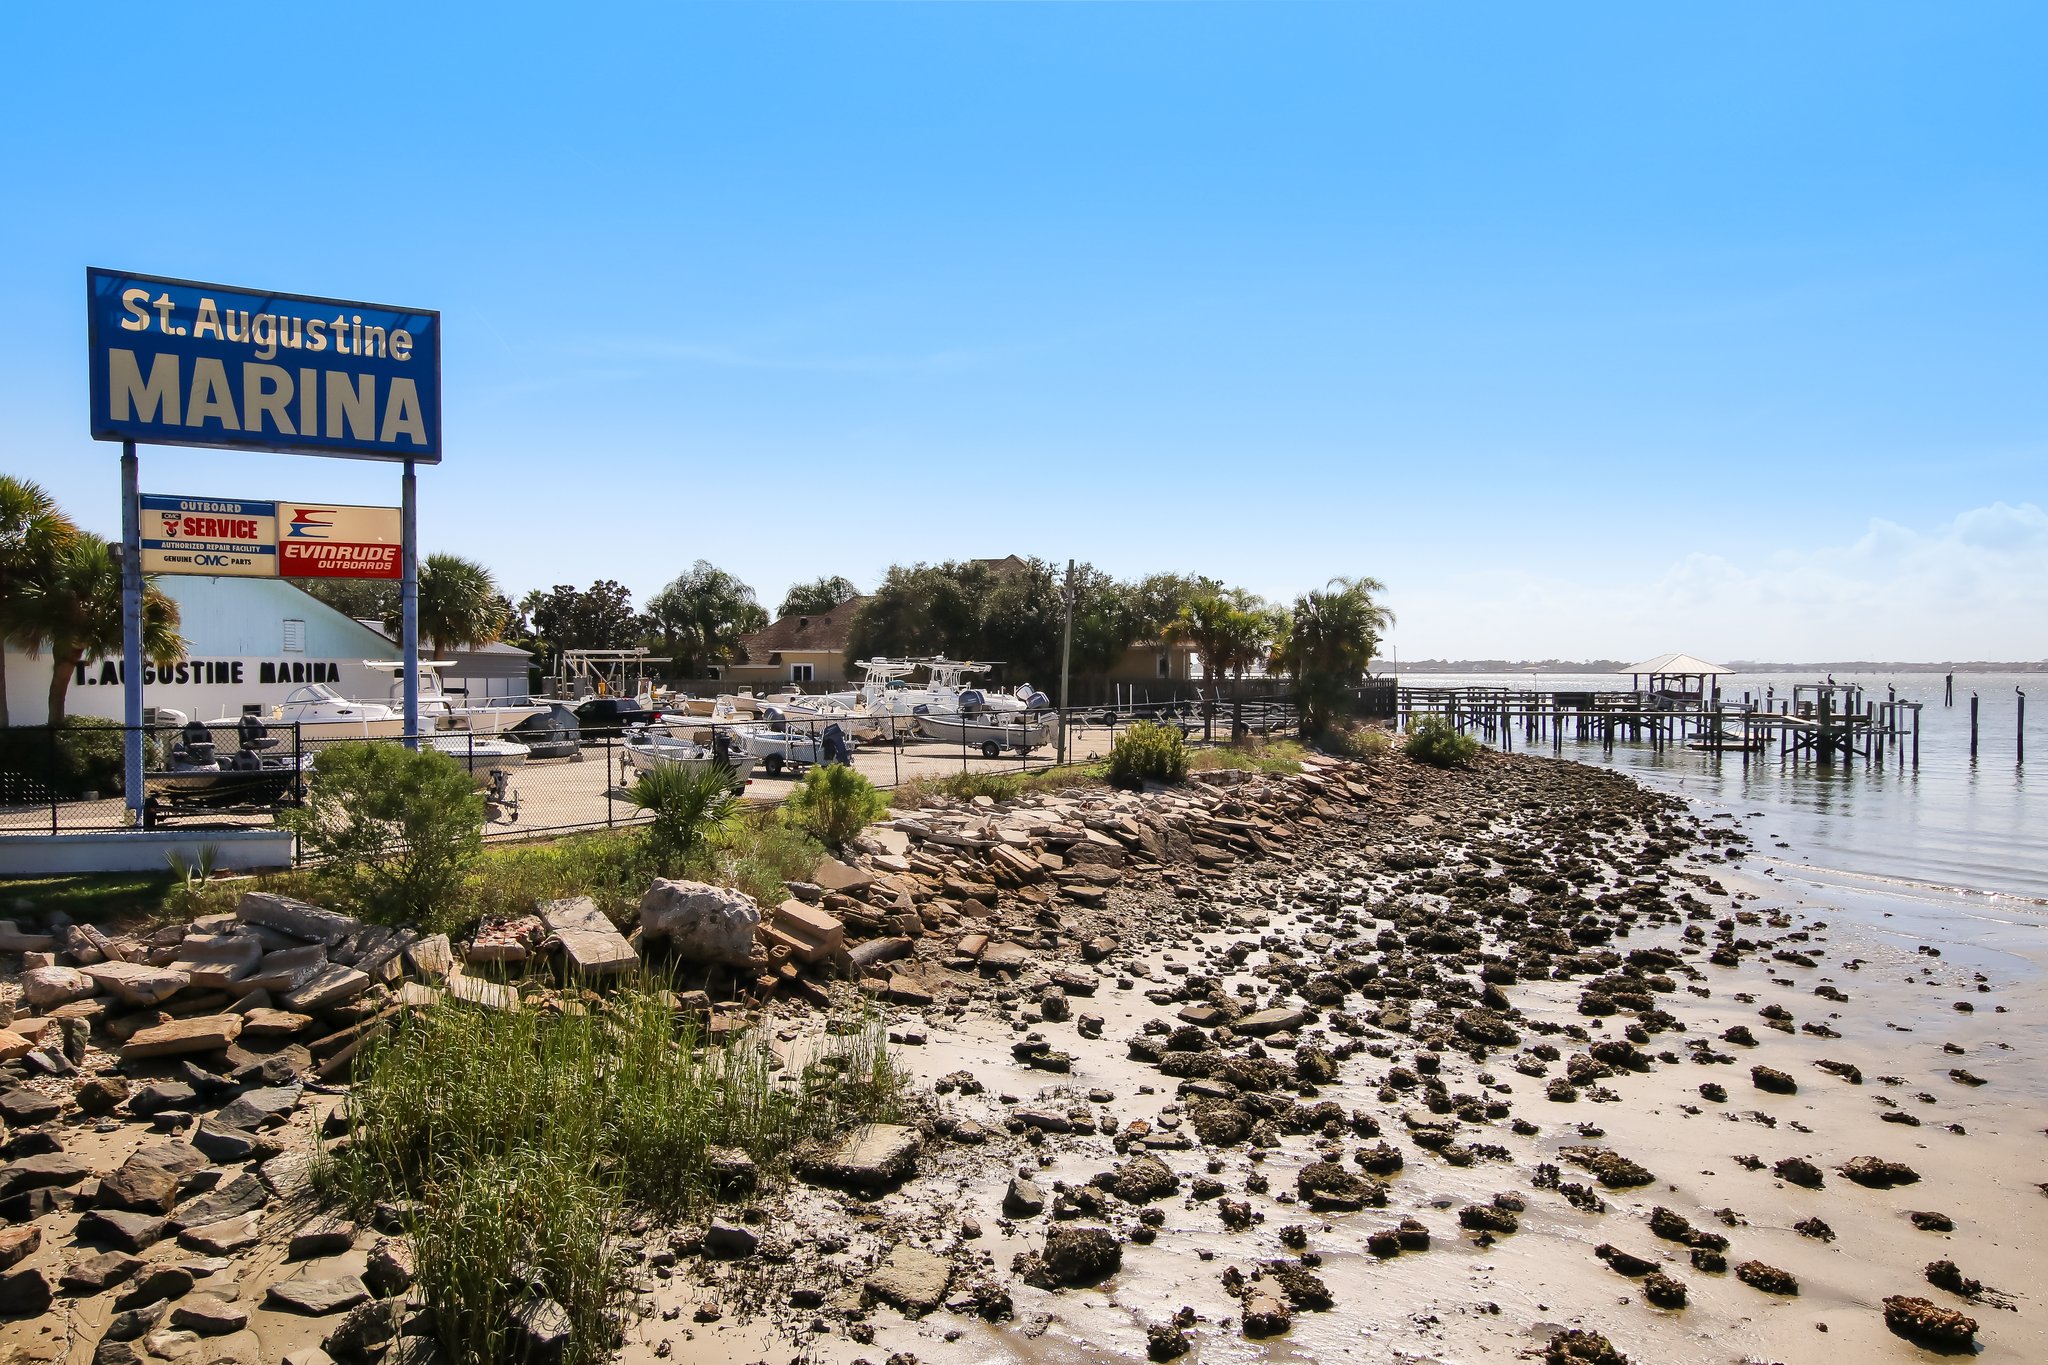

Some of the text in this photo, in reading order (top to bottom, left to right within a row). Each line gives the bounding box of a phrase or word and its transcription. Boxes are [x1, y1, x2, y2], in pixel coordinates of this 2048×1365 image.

[108, 347, 427, 445] MARINA
[180, 501, 242, 513] OUTBOARD
[183, 517, 258, 539] SERVICE
[161, 541, 204, 549] AUTHORIZED
[206, 544, 231, 552] REPAIR
[284, 544, 396, 561] EVINRUDE
[194, 554, 229, 567] OMC
[317, 560, 392, 570] OUTBOARDS
[260, 661, 340, 684] MARINA
